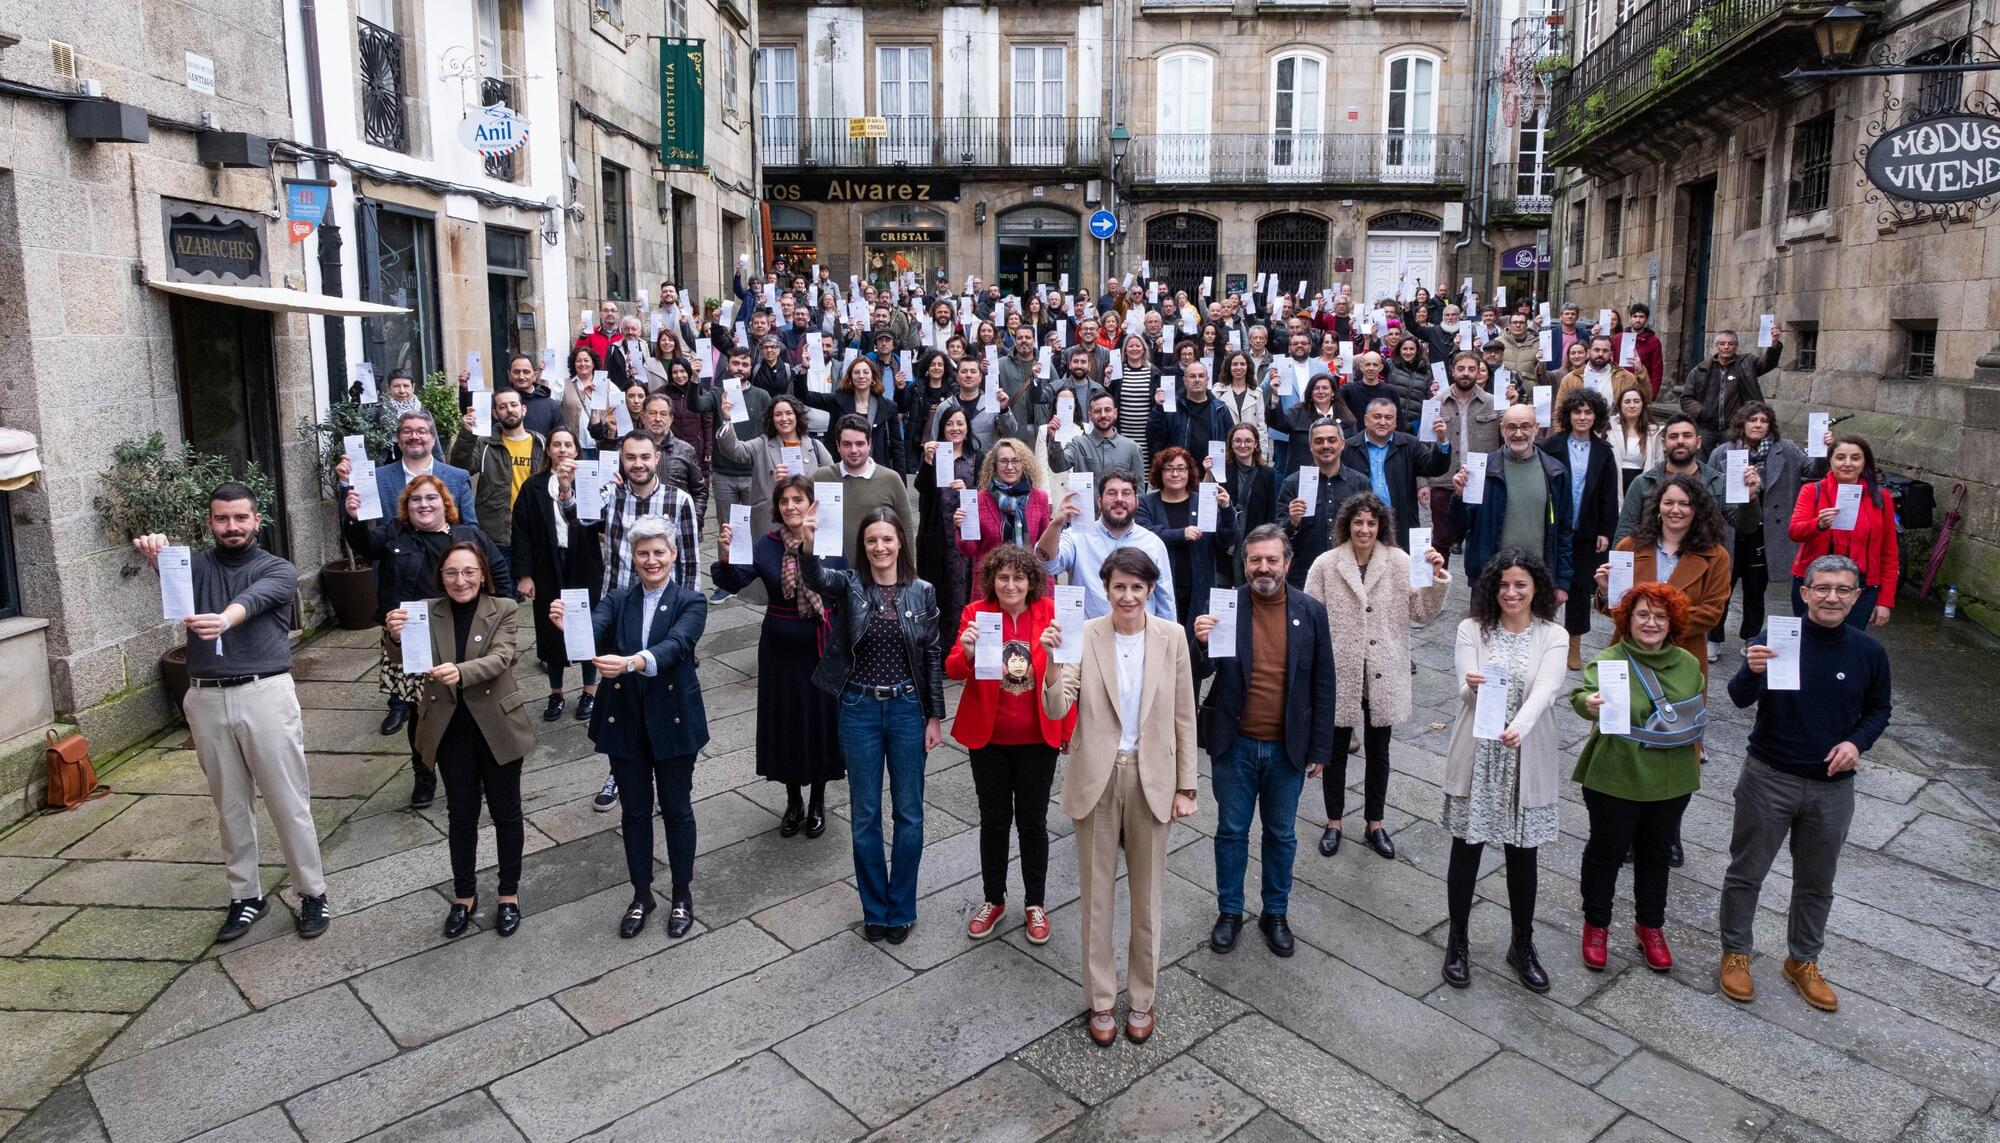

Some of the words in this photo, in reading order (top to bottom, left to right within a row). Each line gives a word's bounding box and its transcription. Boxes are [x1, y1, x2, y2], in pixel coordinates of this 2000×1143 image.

[665, 63, 676, 140] FLORISTERÍA
[475, 121, 512, 141] Anil
[1891, 122, 2000, 157] MODUS
[827, 180, 930, 200] Alvarez
[176, 235, 254, 260] AZABACHES
[881, 232, 930, 241] CRISTAL
